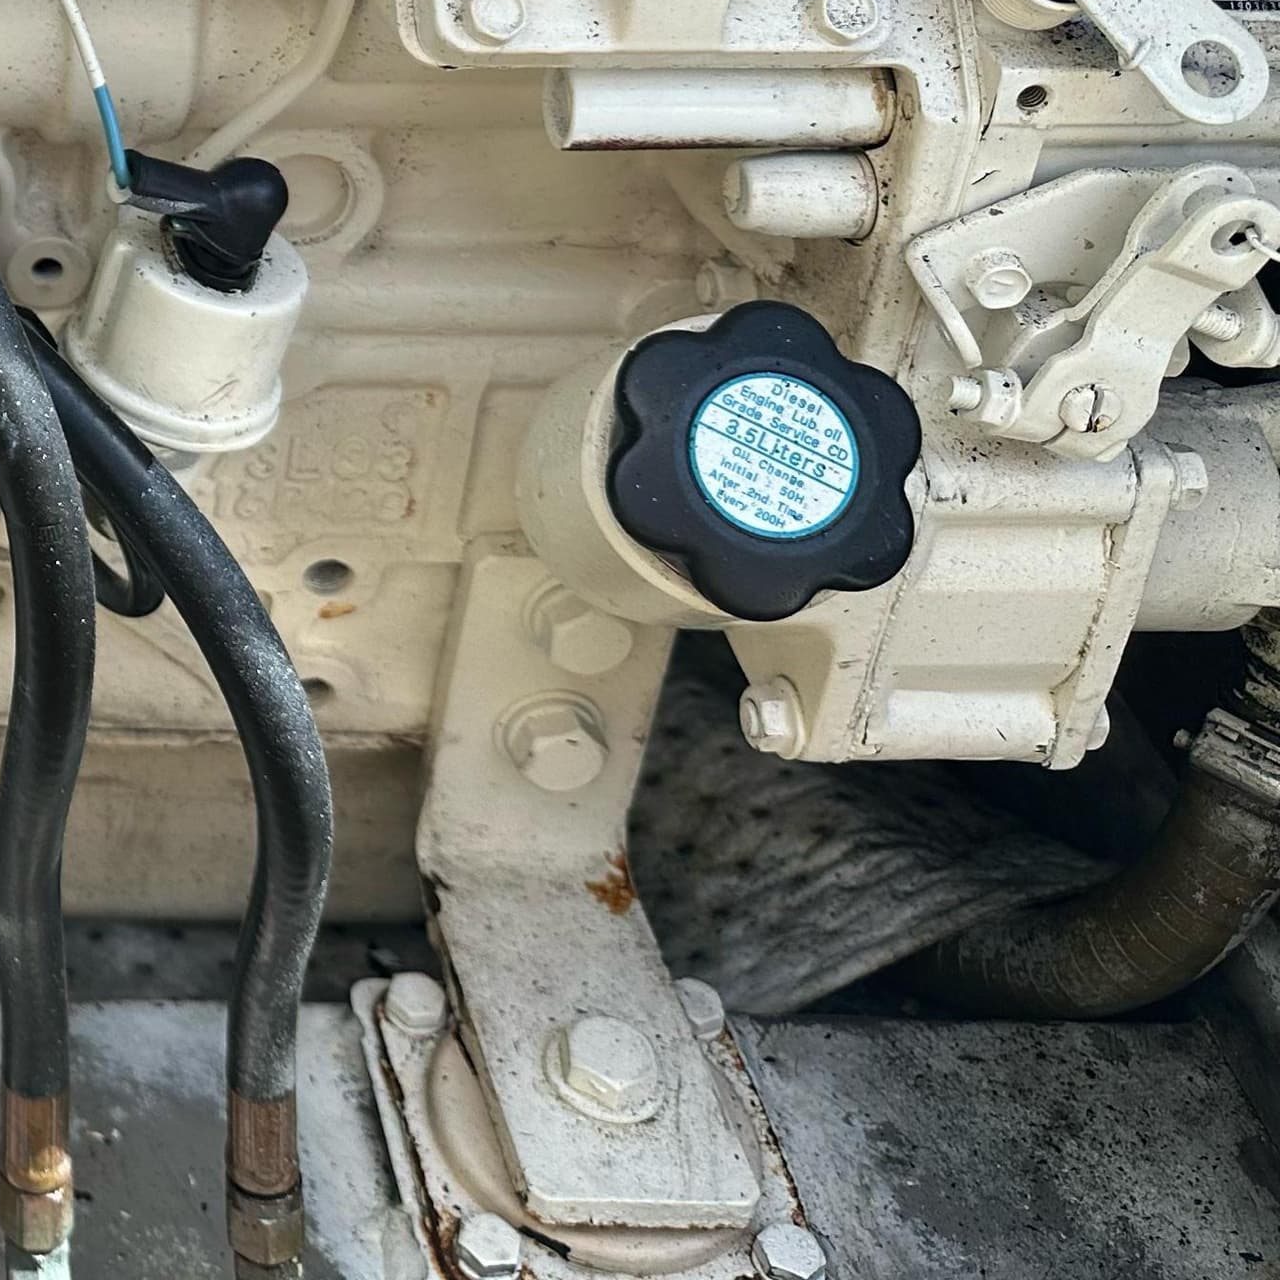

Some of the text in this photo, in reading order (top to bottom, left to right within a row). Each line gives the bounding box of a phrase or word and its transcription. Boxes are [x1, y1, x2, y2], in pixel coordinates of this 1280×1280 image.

[740, 384, 785, 414] Engine
[770, 382, 823, 416] Diesel
[721, 393, 849, 462] Grade Service CD
[719, 456, 759, 483] Initial
[778, 485, 805, 506] 50H
[758, 458, 805, 489] Change
[708, 468, 804, 523] After 2nd Time
[715, 488, 787, 529] Every 200H
